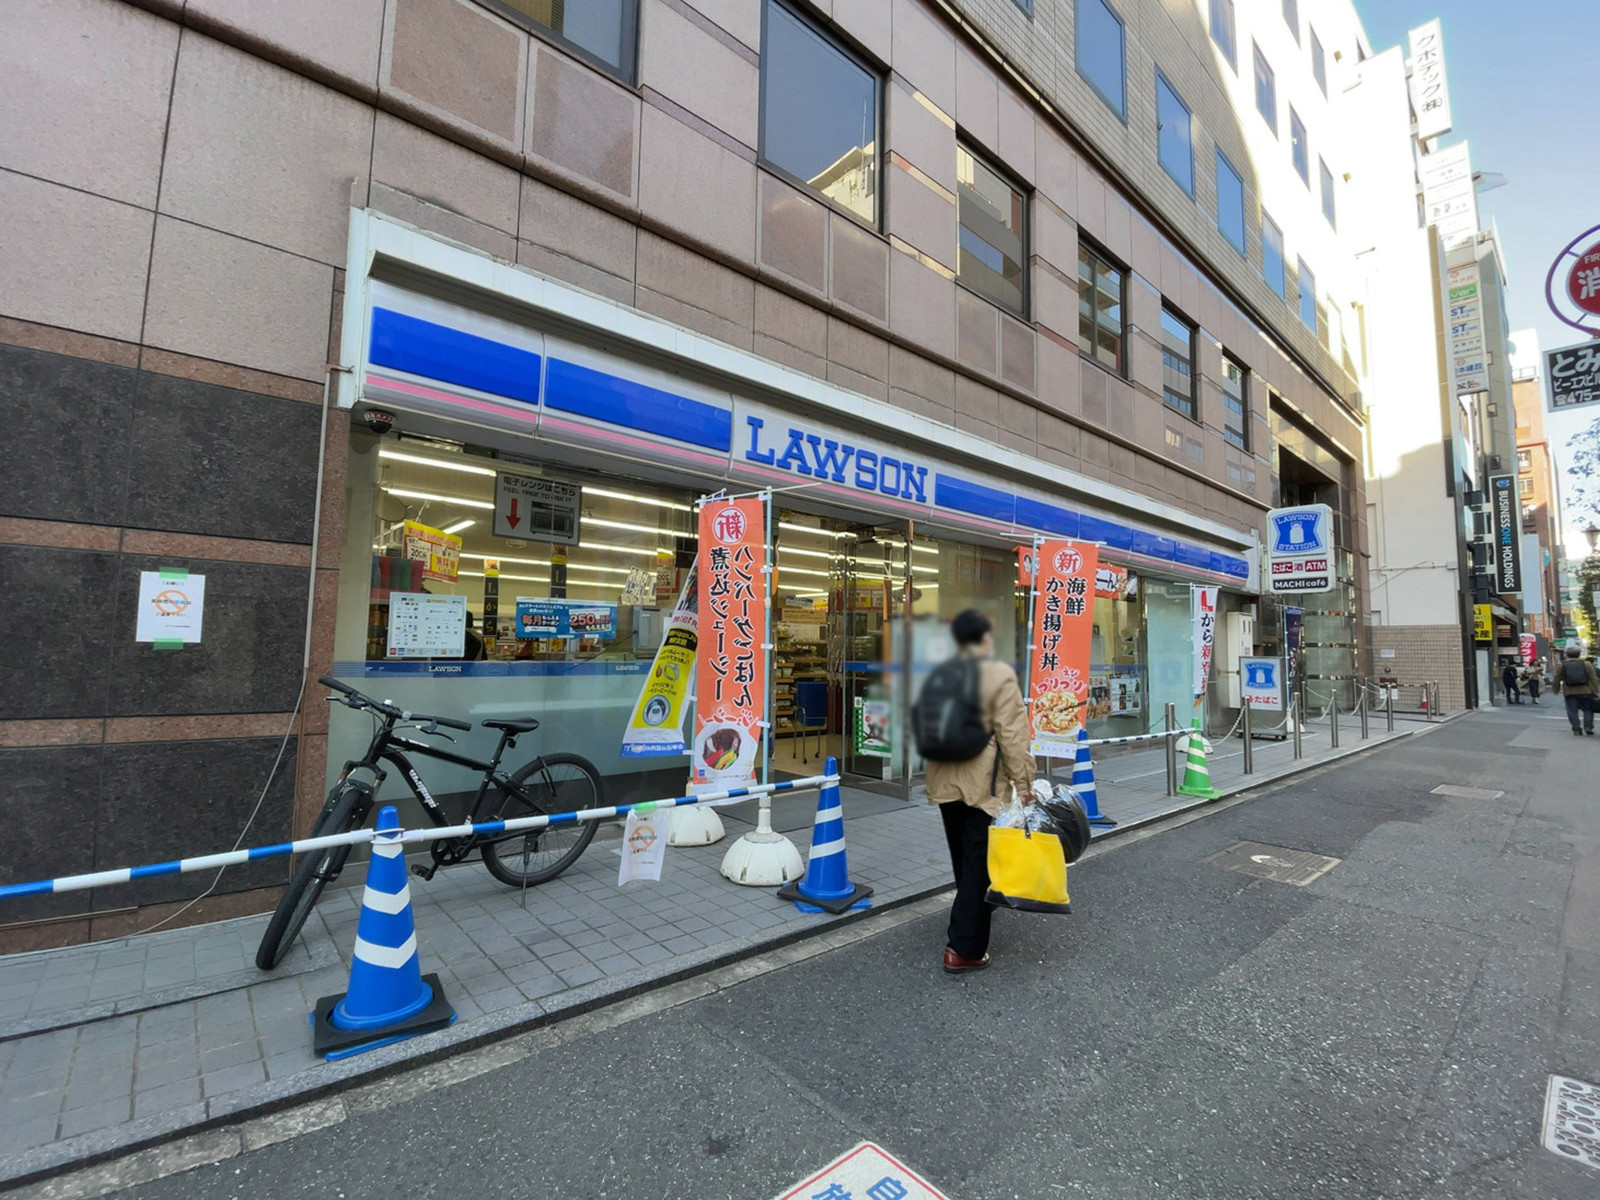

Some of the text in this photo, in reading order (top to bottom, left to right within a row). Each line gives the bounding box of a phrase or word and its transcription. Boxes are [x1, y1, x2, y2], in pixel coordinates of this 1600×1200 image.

[745, 416, 928, 503] LAWSON
[503, 486, 520, 494] FEEL
[522, 489, 539, 497] FREE
[1277, 514, 1316, 524] LAWSON
[1278, 541, 1316, 551] STATION
[1057, 552, 1079, 572] 新
[1306, 562, 1326, 571] ATM
[1502, 546, 1515, 588] HOLDINGS
[1305, 578, 1326, 587] café
[1065, 577, 1087, 615] 海鮮
[1041, 576, 1064, 671] かき揚げ丼
